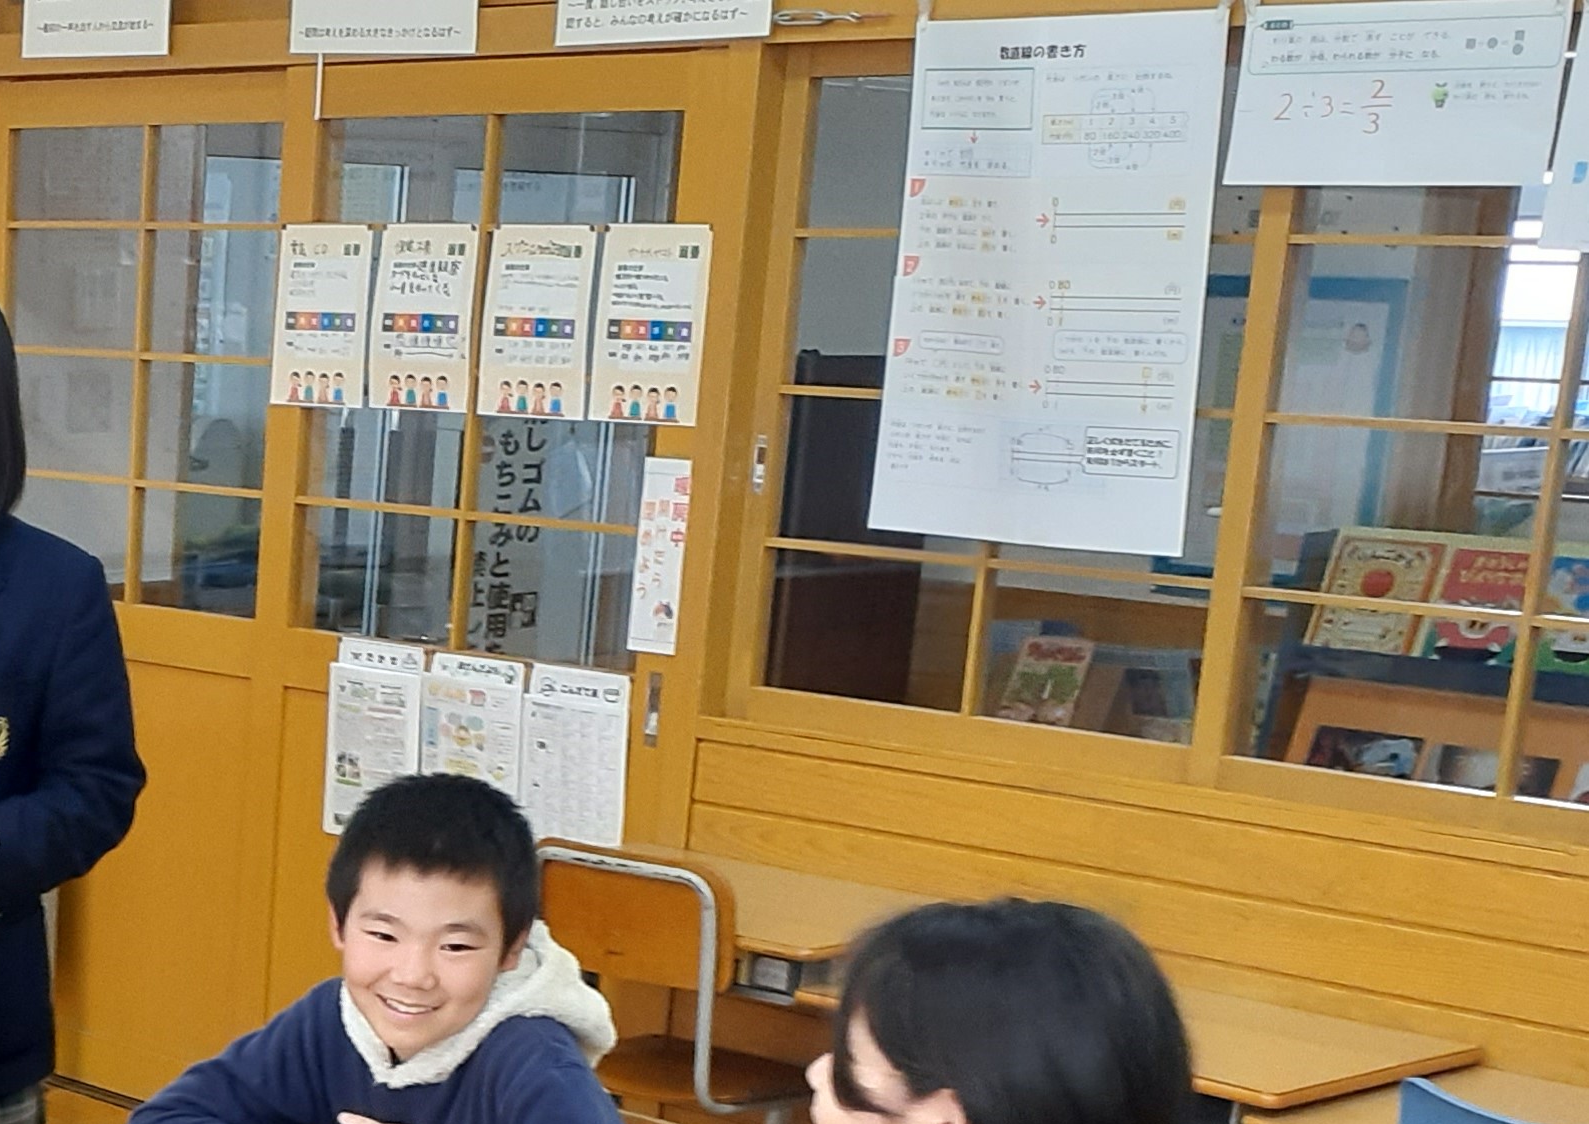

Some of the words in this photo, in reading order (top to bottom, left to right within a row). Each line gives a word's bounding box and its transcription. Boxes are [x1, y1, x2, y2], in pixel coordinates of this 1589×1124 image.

[999, 44, 1087, 60] 数直線の書き方
